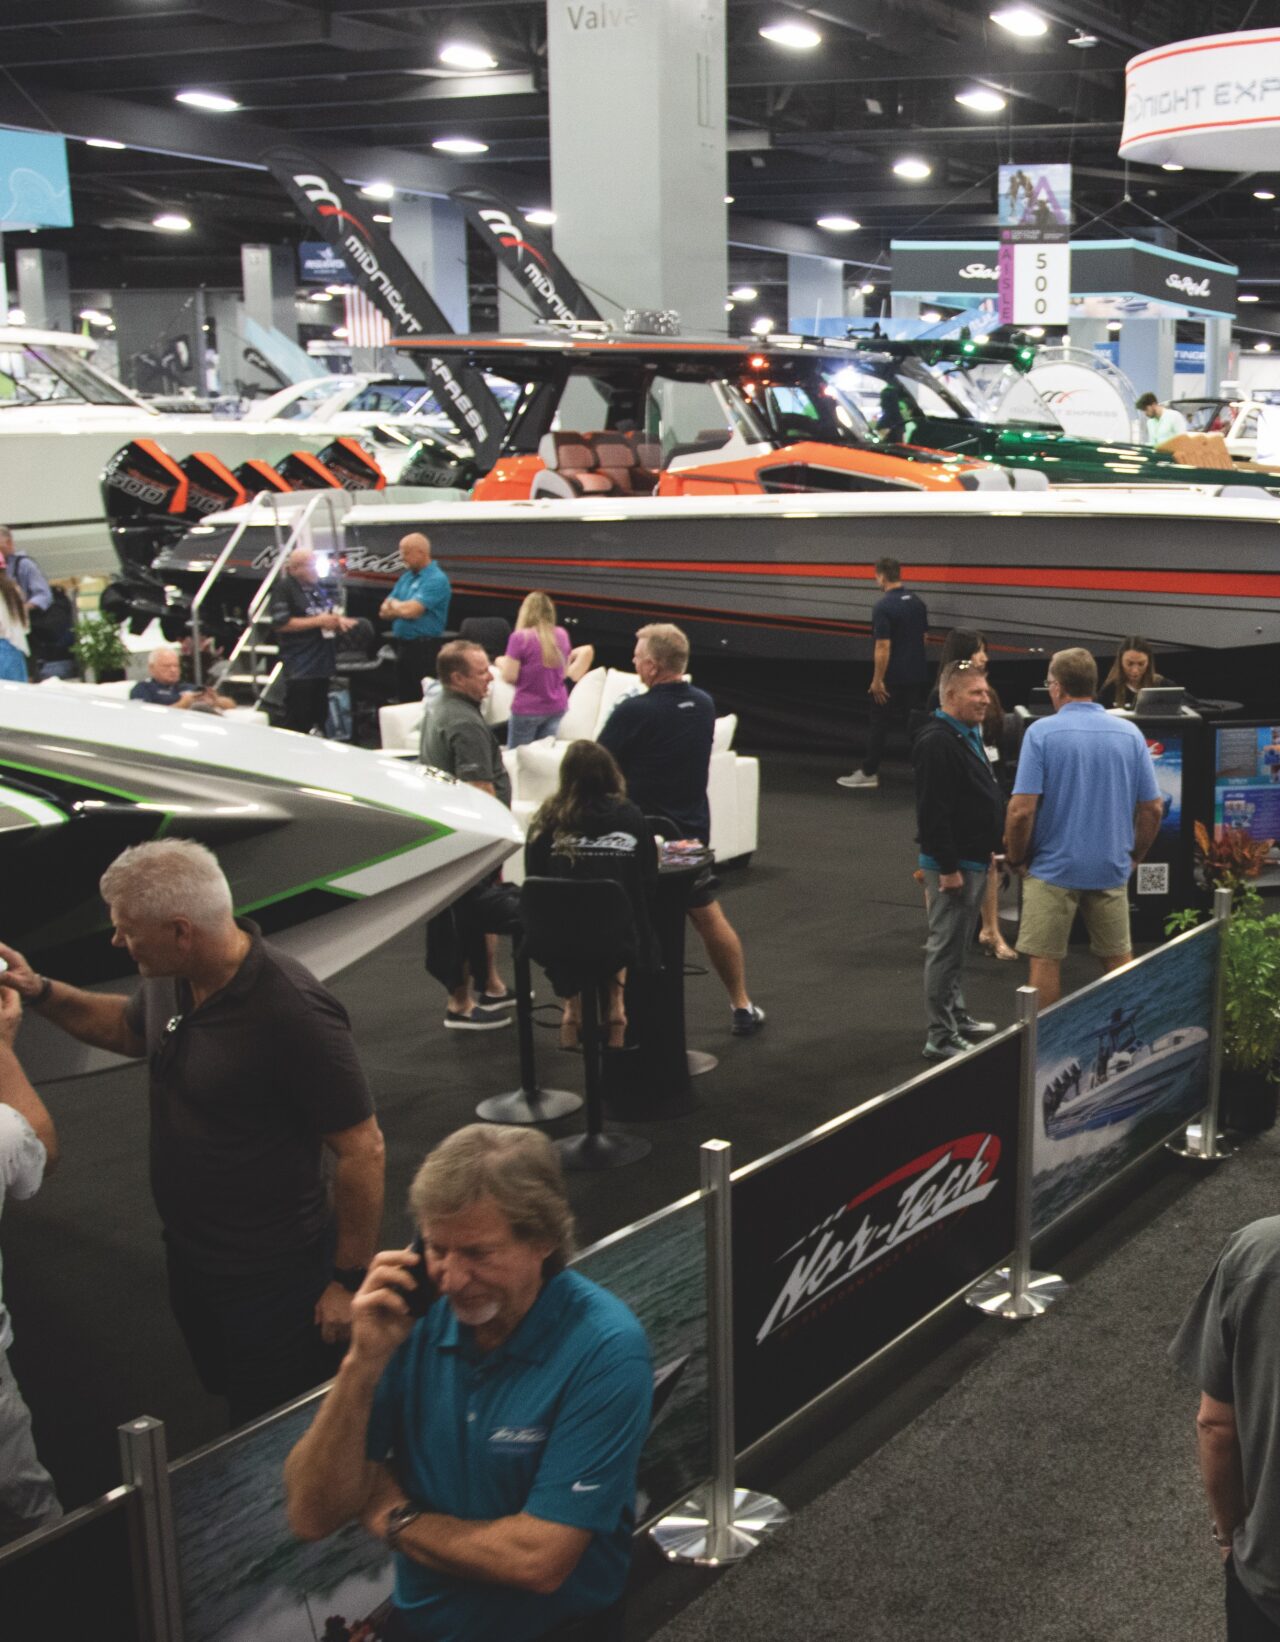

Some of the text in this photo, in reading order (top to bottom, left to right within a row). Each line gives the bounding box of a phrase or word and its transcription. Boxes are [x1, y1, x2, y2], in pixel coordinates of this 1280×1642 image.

[344, 235, 423, 334] MIDNIGHT
[1002, 249, 1011, 325] AISLE
[1034, 252, 1049, 316] 500
[756, 1134, 995, 1346] Nor-Tech
